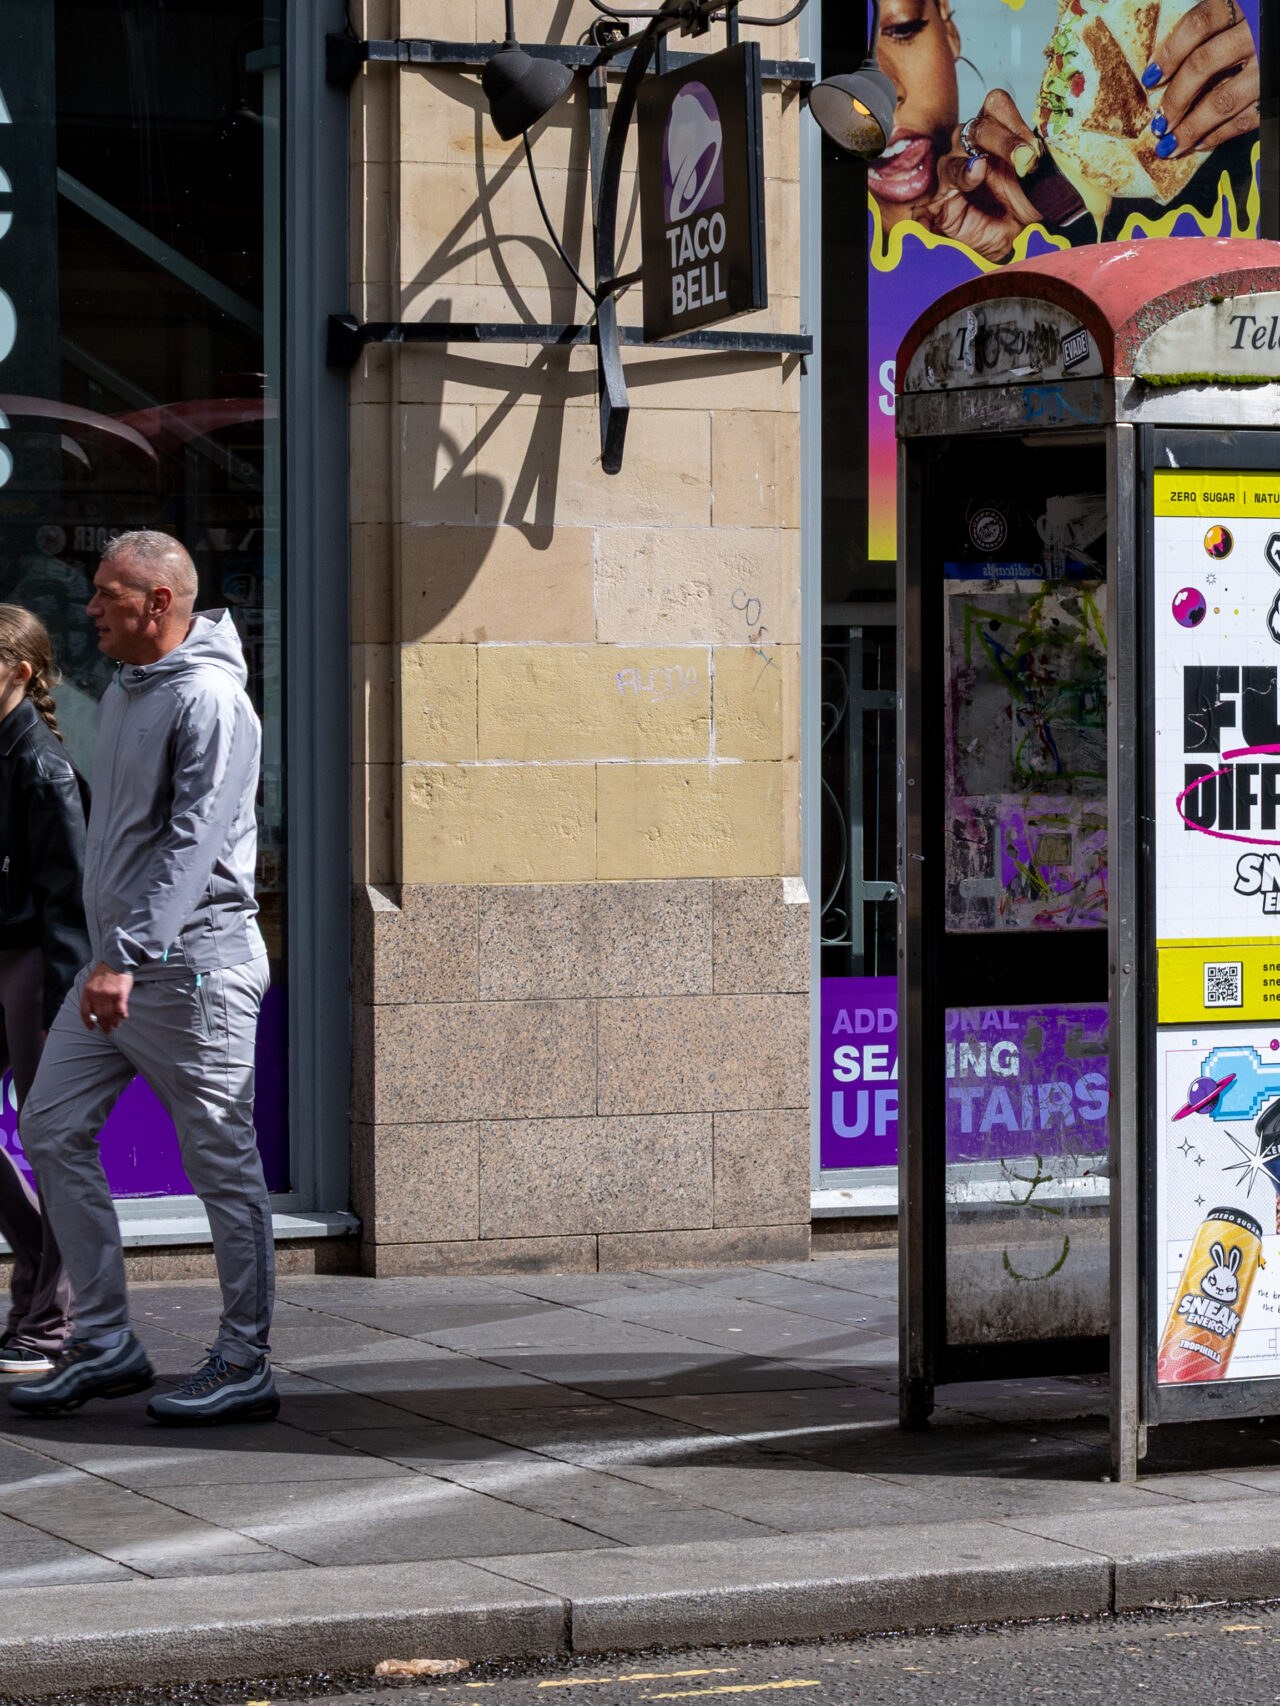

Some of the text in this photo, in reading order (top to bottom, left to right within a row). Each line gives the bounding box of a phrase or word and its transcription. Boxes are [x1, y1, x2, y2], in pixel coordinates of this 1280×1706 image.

[666, 212, 727, 268] TACO
[671, 261, 727, 316] BELL
[1065, 332, 1087, 363] EVADE
[1170, 491, 1197, 502] ZERO
[1203, 492, 1236, 503] SUGAR
[832, 1007, 1019, 1034] ADDONAL
[832, 1040, 1020, 1082] SEING
[831, 1072, 1110, 1138] UPTAIRS
[1257, 1289, 1269, 1298] the
[1262, 1303, 1274, 1313] the
[1177, 1293, 1241, 1336] SNEAK
[1186, 1313, 1233, 1338] ENERGY
[1179, 1339, 1222, 1364] TROPIKILLA
